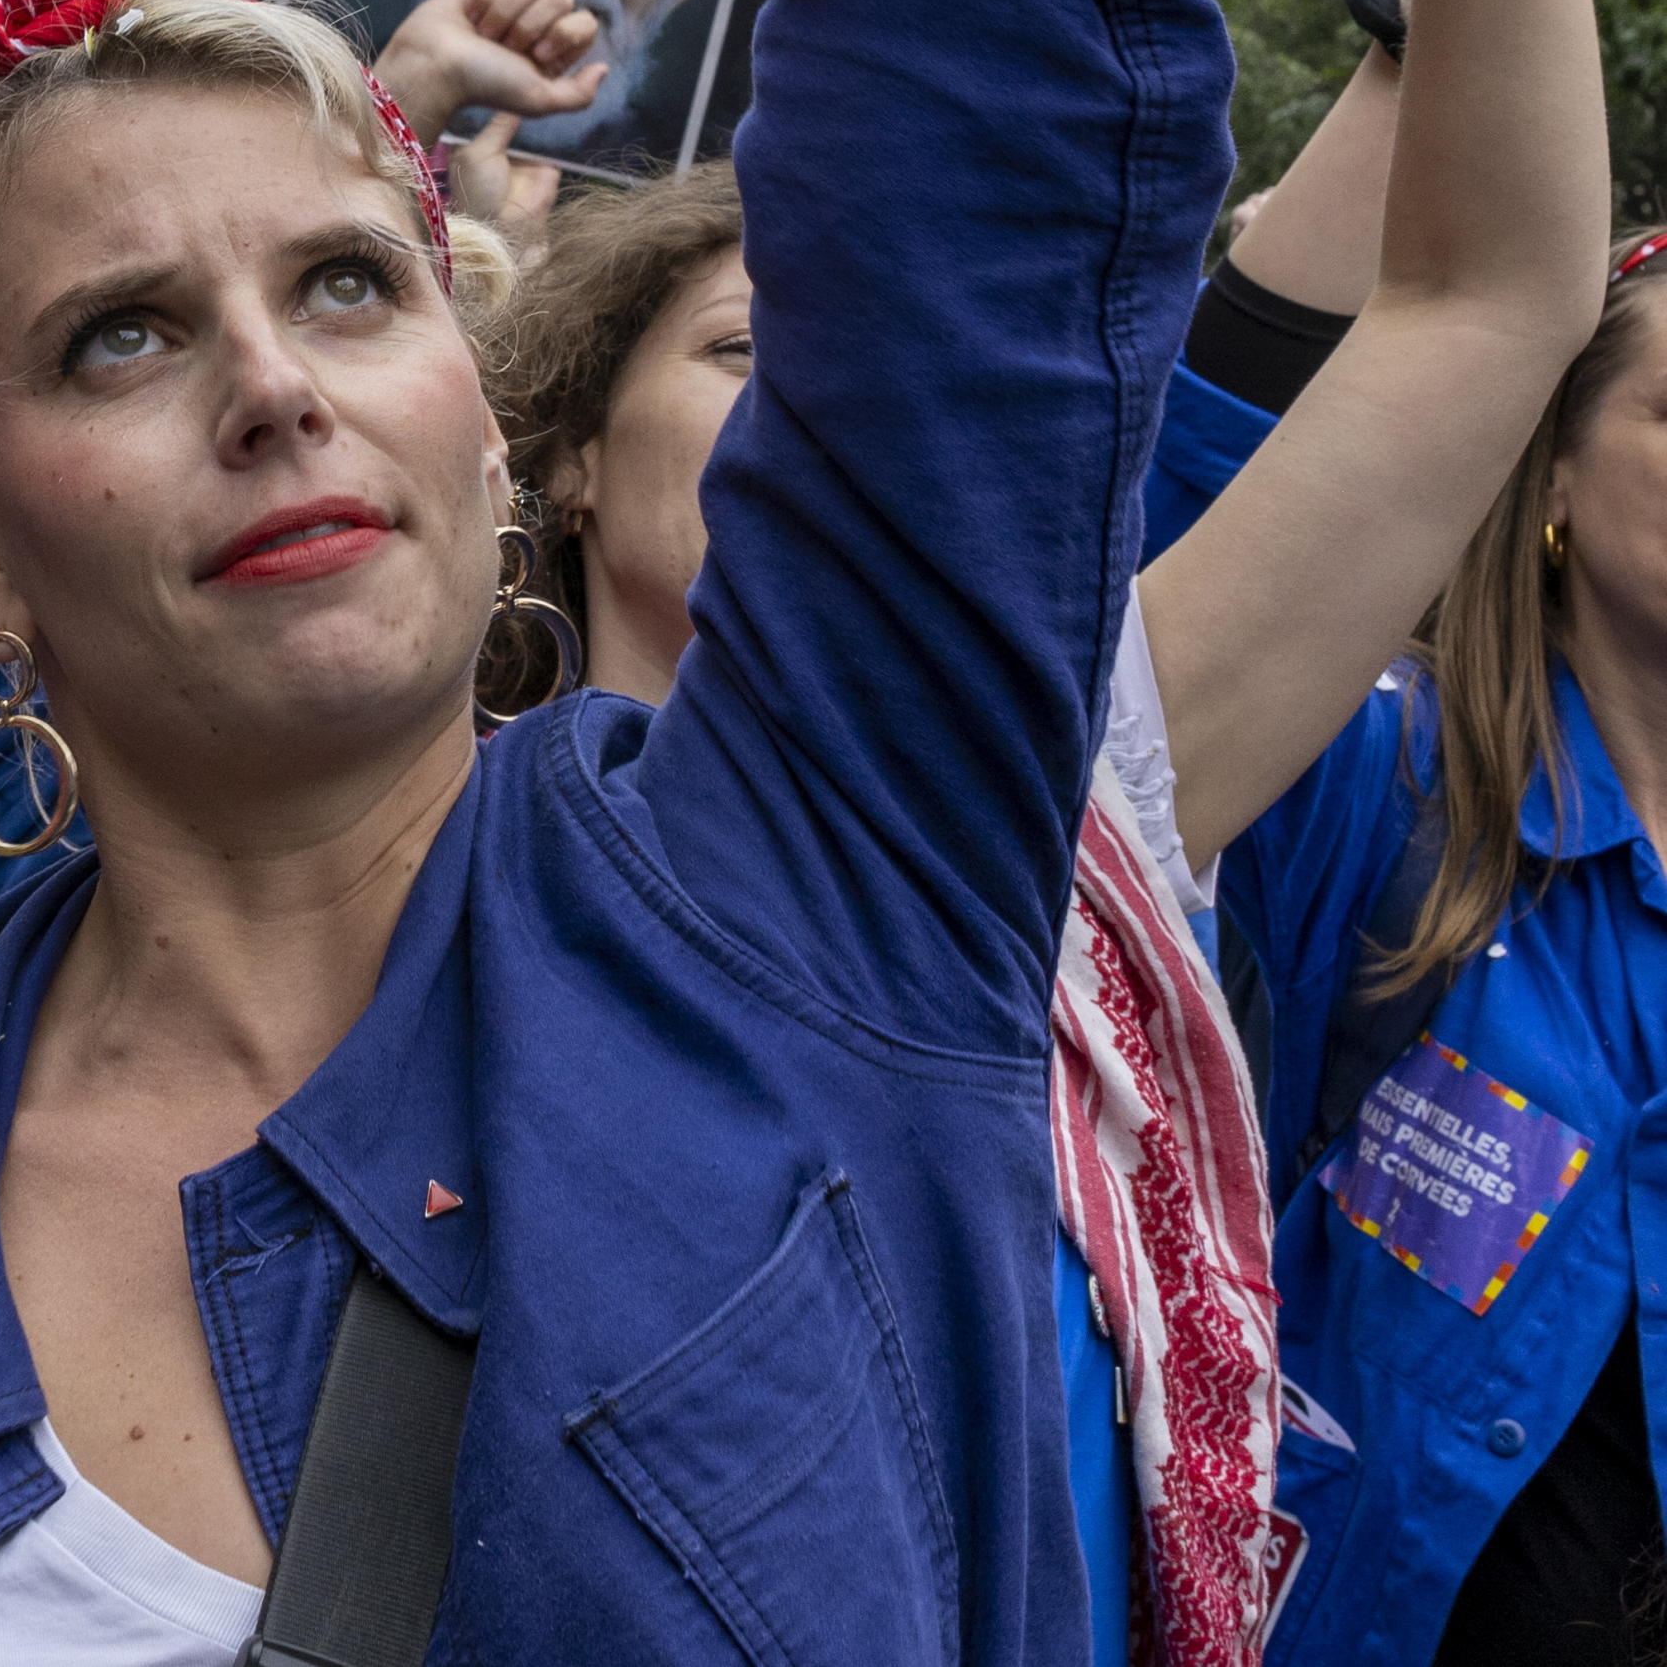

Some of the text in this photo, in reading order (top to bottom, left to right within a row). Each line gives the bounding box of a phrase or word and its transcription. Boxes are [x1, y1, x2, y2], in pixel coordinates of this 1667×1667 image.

[1376, 1076, 1511, 1172] ESSENTIELLES,
[1394, 1122, 1516, 1205] PREMIÈRES
[1358, 1137, 1473, 1217] DE CORVÉES
